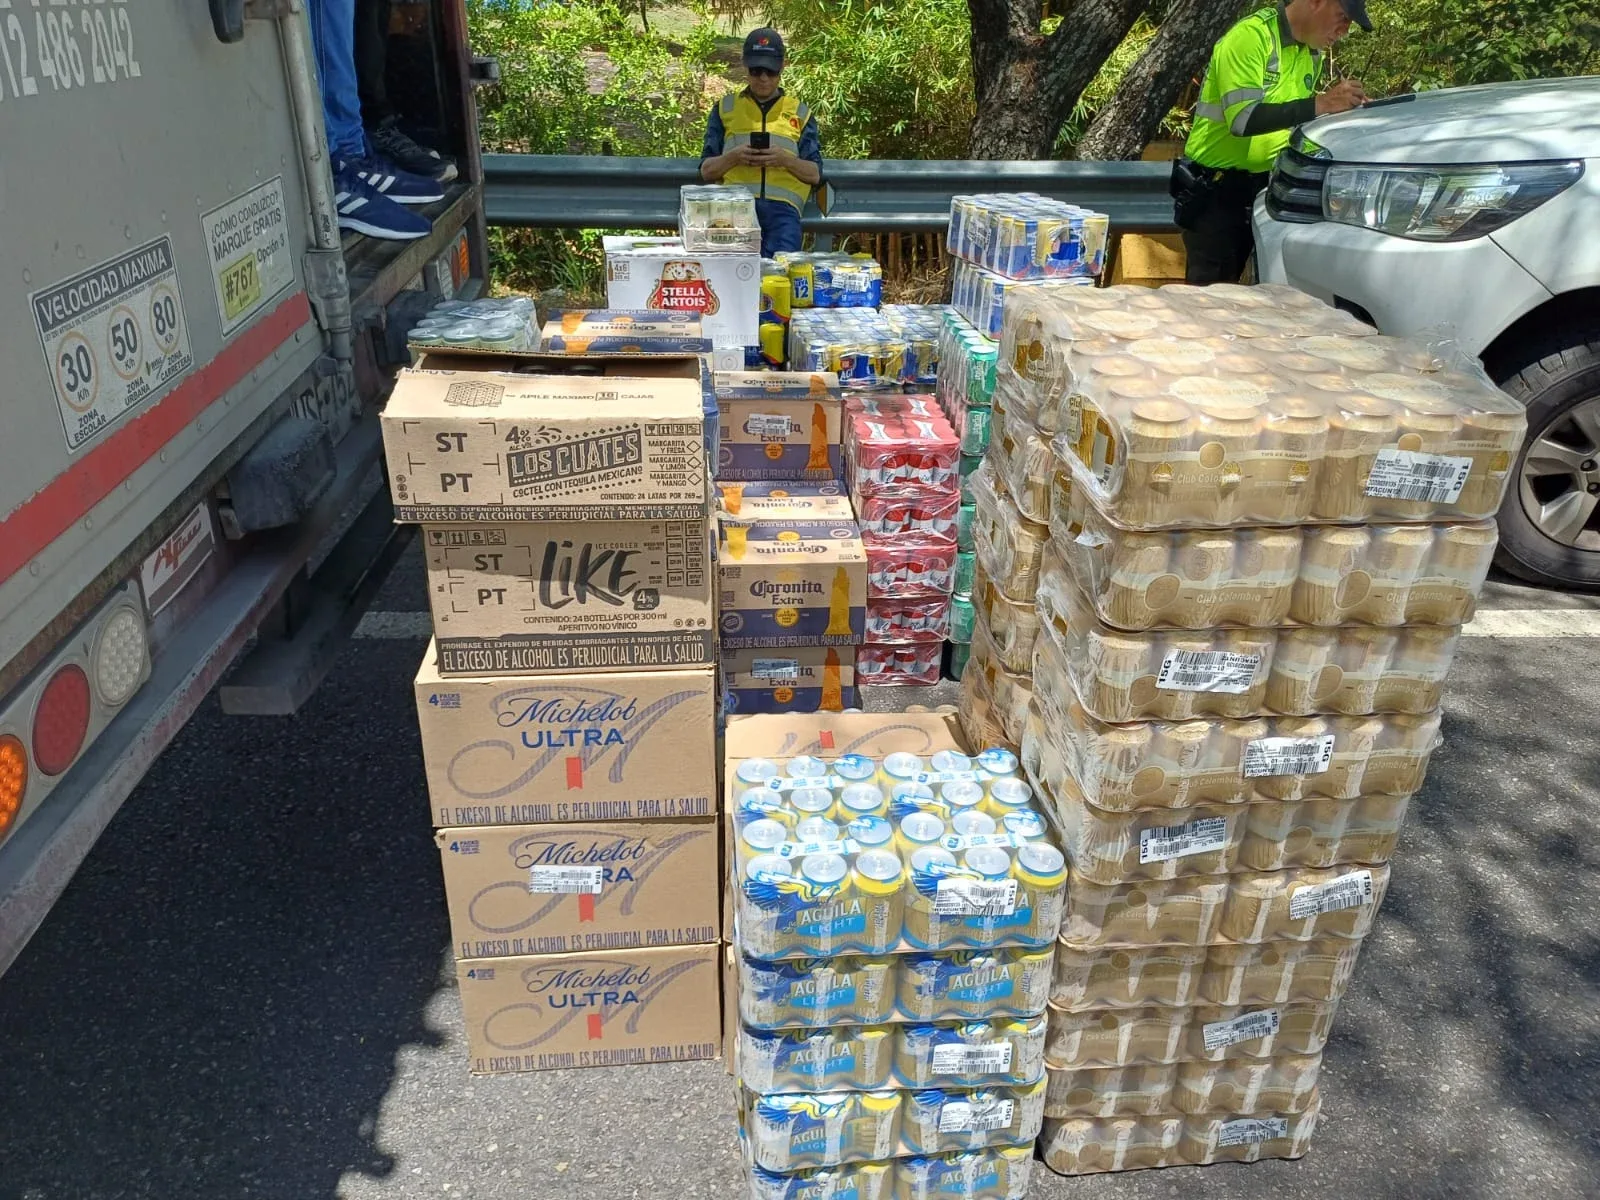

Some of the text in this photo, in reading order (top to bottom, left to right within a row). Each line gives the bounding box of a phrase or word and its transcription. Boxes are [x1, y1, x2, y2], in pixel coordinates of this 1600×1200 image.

[0, 7, 141, 100] 12 486 2042
[211, 191, 279, 244] ¿CÓMO CONDUZCO?
[213, 207, 282, 262] MARQUE GRATIS
[256, 233, 285, 263] Opción 3
[40, 270, 118, 324] VELOCIDAD
[119, 248, 167, 288] MAXIMA
[225, 260, 254, 303] #767
[661, 287, 705, 297] STELLA
[795, 285, 808, 298] 12
[661, 297, 706, 307] ARTOIS
[153, 295, 176, 336] 80
[111, 318, 137, 361] 50
[61, 344, 92, 393] 30
[160, 355, 192, 382] CARRETERA
[167, 350, 183, 366] ZONA
[125, 384, 151, 406] URBANA
[126, 376, 144, 394] ZONA
[74, 415, 107, 442] ESCOLAR
[78, 408, 99, 428] ZONA
[435, 432, 468, 453] ST
[505, 425, 531, 444] 4%
[511, 432, 639, 478] LOS CUATES
[440, 473, 473, 493] PT
[513, 465, 643, 498] COCTEL CON TEQUILA MEXICANO
[1177, 473, 1197, 484] Club
[401, 510, 700, 520] EL EXCESO DE ALCOHOL ES PERJUDICIAL PARA LA SALUD
[473, 532, 481, 540] 6
[753, 545, 828, 555] Coronita
[474, 553, 503, 571] ST
[477, 588, 507, 605] PT
[636, 590, 654, 603] 4%
[750, 580, 825, 598] Coronita
[771, 596, 804, 605] Extra
[523, 616, 571, 624] CONTENIDO:
[583, 614, 623, 622] BOTELLAS
[623, 613, 640, 621] POR
[640, 612, 656, 620] 300
[656, 612, 667, 620] ml
[557, 623, 611, 632] APERITIVO NO
[574, 638, 629, 646] EMBRIAGANTES
[443, 643, 705, 670] EL EXCESO DE ALCOHOL ES PERJUDICIAL PARA LA SALUD
[1158, 659, 1172, 682] 15G
[428, 693, 439, 706] 4
[497, 697, 637, 727] Michelob
[521, 728, 625, 749] ULTRA
[1322, 740, 1333, 762] 15G
[440, 797, 708, 825] EL EXCESO DE ALCOHOL ES PERJUDICIAL PARA LA SALUD
[450, 841, 459, 853] 4
[515, 837, 648, 869] Michelob
[1141, 838, 1149, 859] 15G
[1363, 876, 1372, 895] 15G
[801, 899, 861, 925] AGUILA
[809, 917, 855, 934] LIGHT
[461, 926, 714, 957] EL EXCESO DE ALCOHOL ES PERJUDICIAL PARA LA SALUD
[467, 969, 476, 979] 4
[526, 966, 650, 993] Michelob
[952, 965, 1010, 990] AGUILA
[548, 990, 638, 1008] ULTRA
[476, 1043, 714, 1071] EL EXCESO DE ALCOHOL ES PERJUDICIAL PARA LA SALUD
